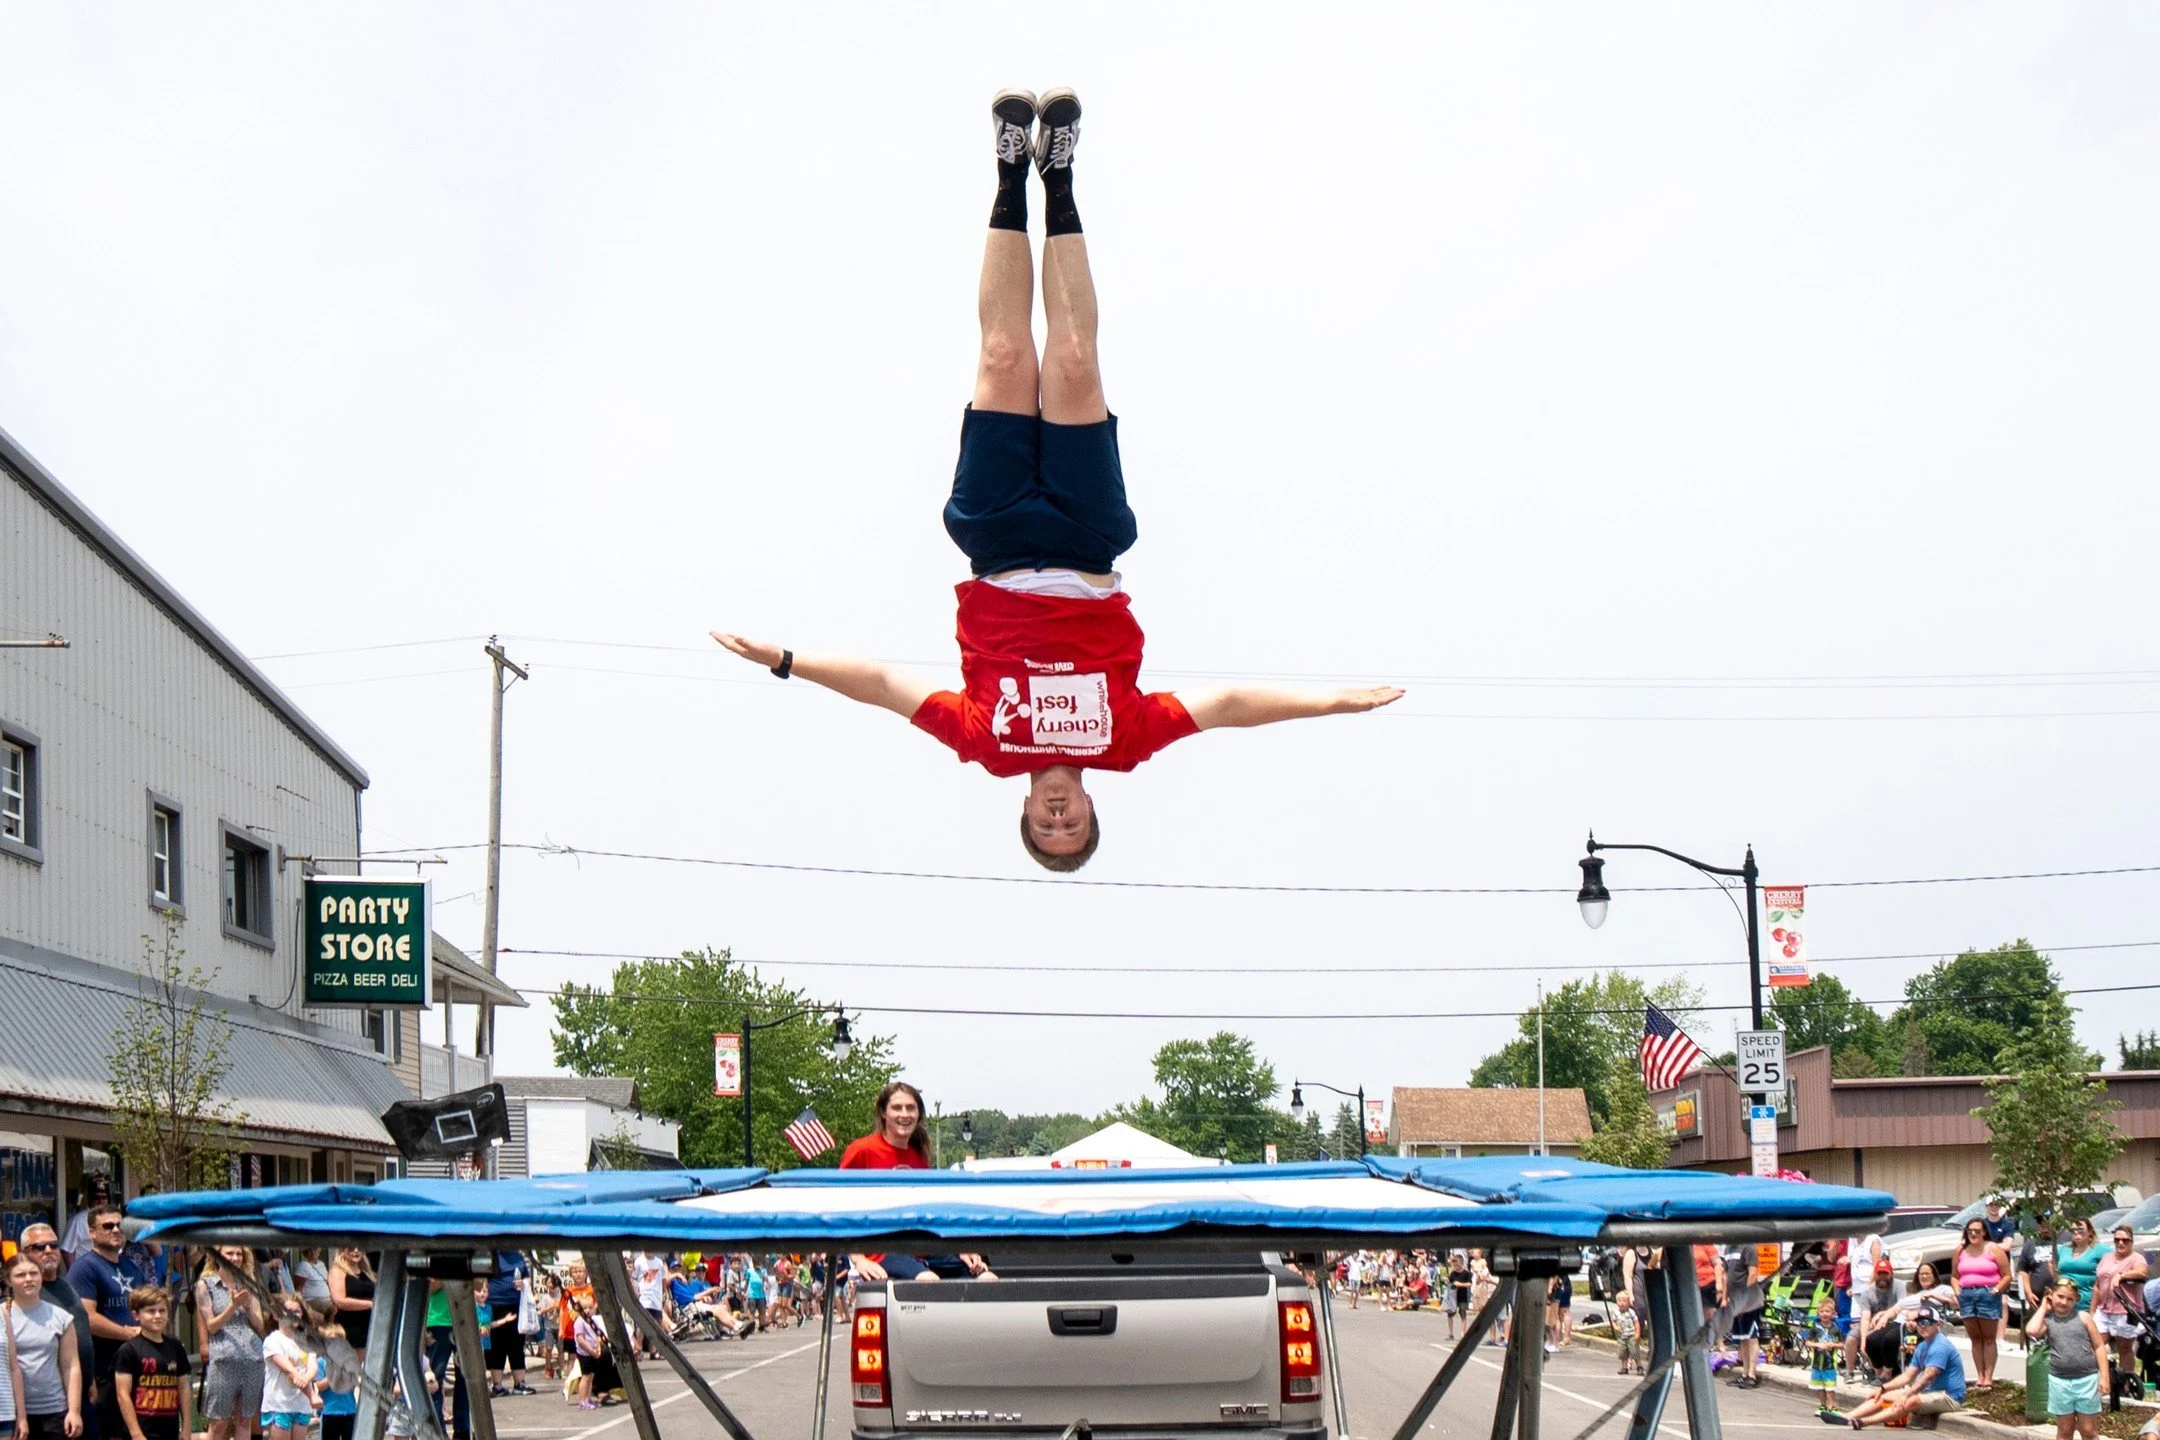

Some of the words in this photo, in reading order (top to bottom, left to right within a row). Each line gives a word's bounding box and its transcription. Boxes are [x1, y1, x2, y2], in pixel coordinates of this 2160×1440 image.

[1036, 695, 1078, 714] fest
[1036, 717, 1099, 733] cherry
[1766, 890, 1802, 899] CHERRY
[320, 895, 410, 924] PARTY
[320, 933, 411, 961] STORE
[313, 972, 348, 986] PIZZA
[354, 973, 386, 986] BEER
[392, 974, 418, 987] DELI
[1741, 1036, 1780, 1046] SPEED
[1745, 1048, 1776, 1058] LIMIT
[1744, 1062, 1781, 1084] 25
[141, 1357, 157, 1373] 23
[139, 1374, 178, 1387] CLEVELAN
[906, 1410, 989, 1422] SIERRA
[1221, 1403, 1269, 1415] GMC
